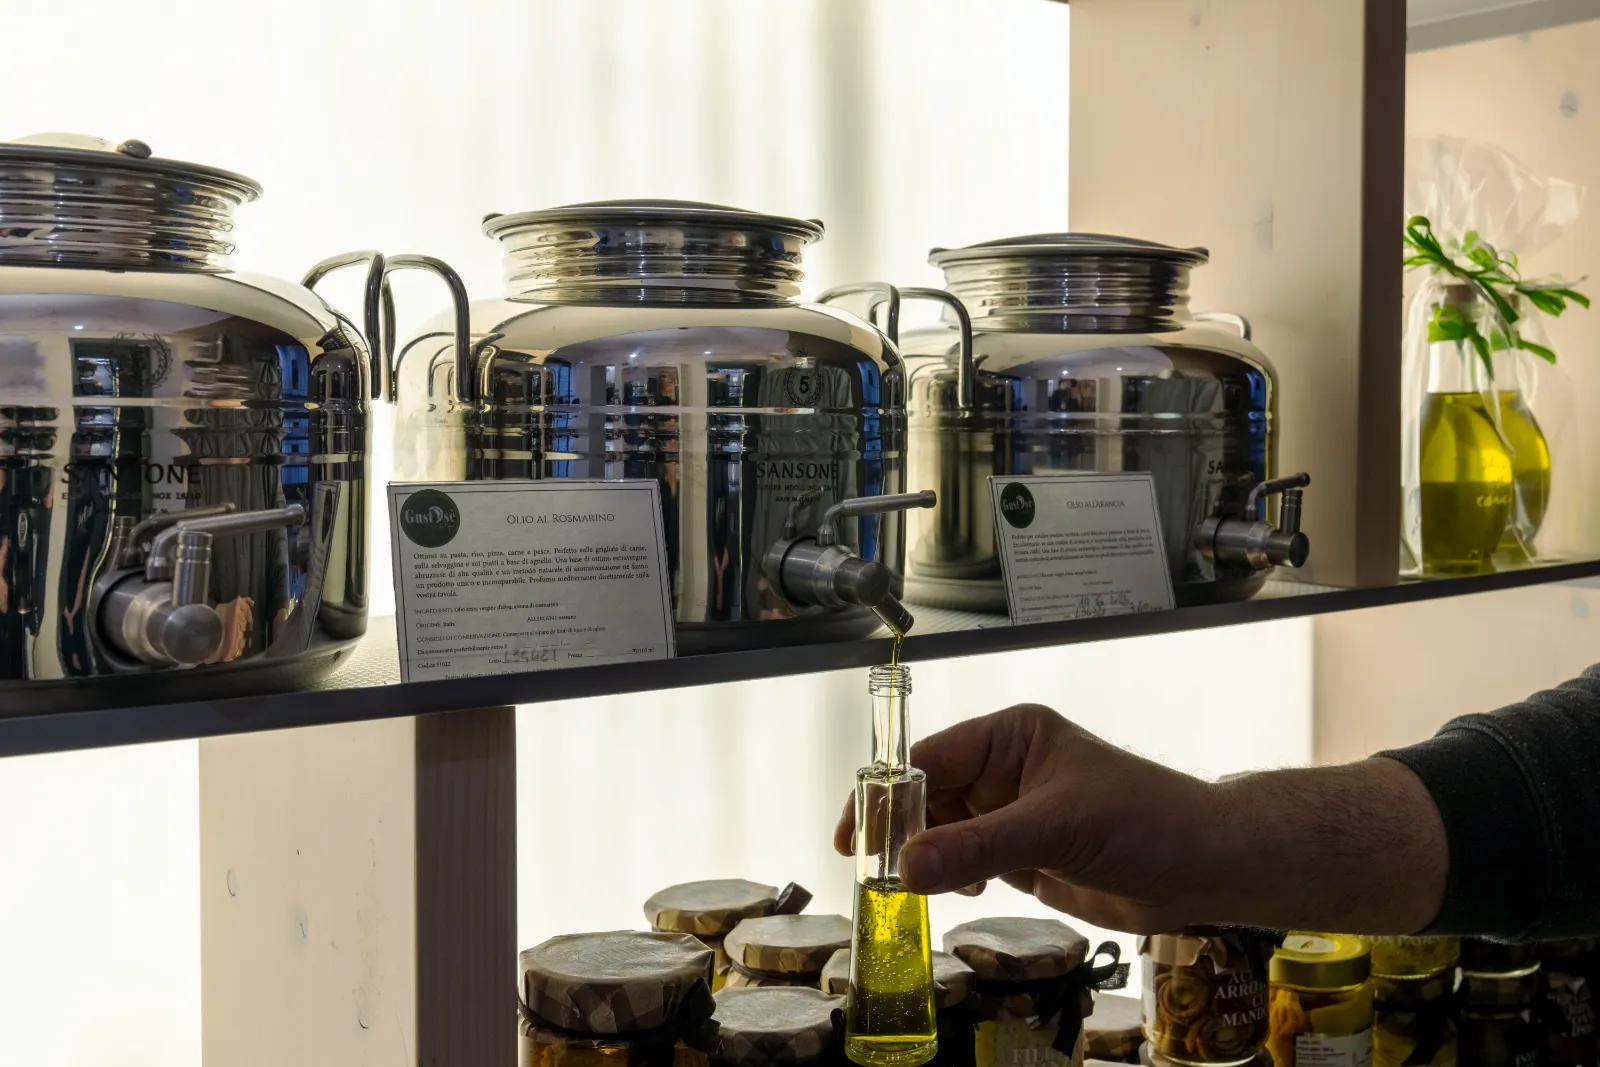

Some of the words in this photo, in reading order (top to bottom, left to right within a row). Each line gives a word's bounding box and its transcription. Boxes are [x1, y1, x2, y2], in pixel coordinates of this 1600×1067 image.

[800, 376, 810, 394] 5
[757, 462, 838, 480] SANSONE
[1066, 500, 1084, 509] OLIO
[507, 515, 534, 525] OLIO
[536, 516, 549, 524] AL
[552, 513, 615, 524] ROSMARINO
